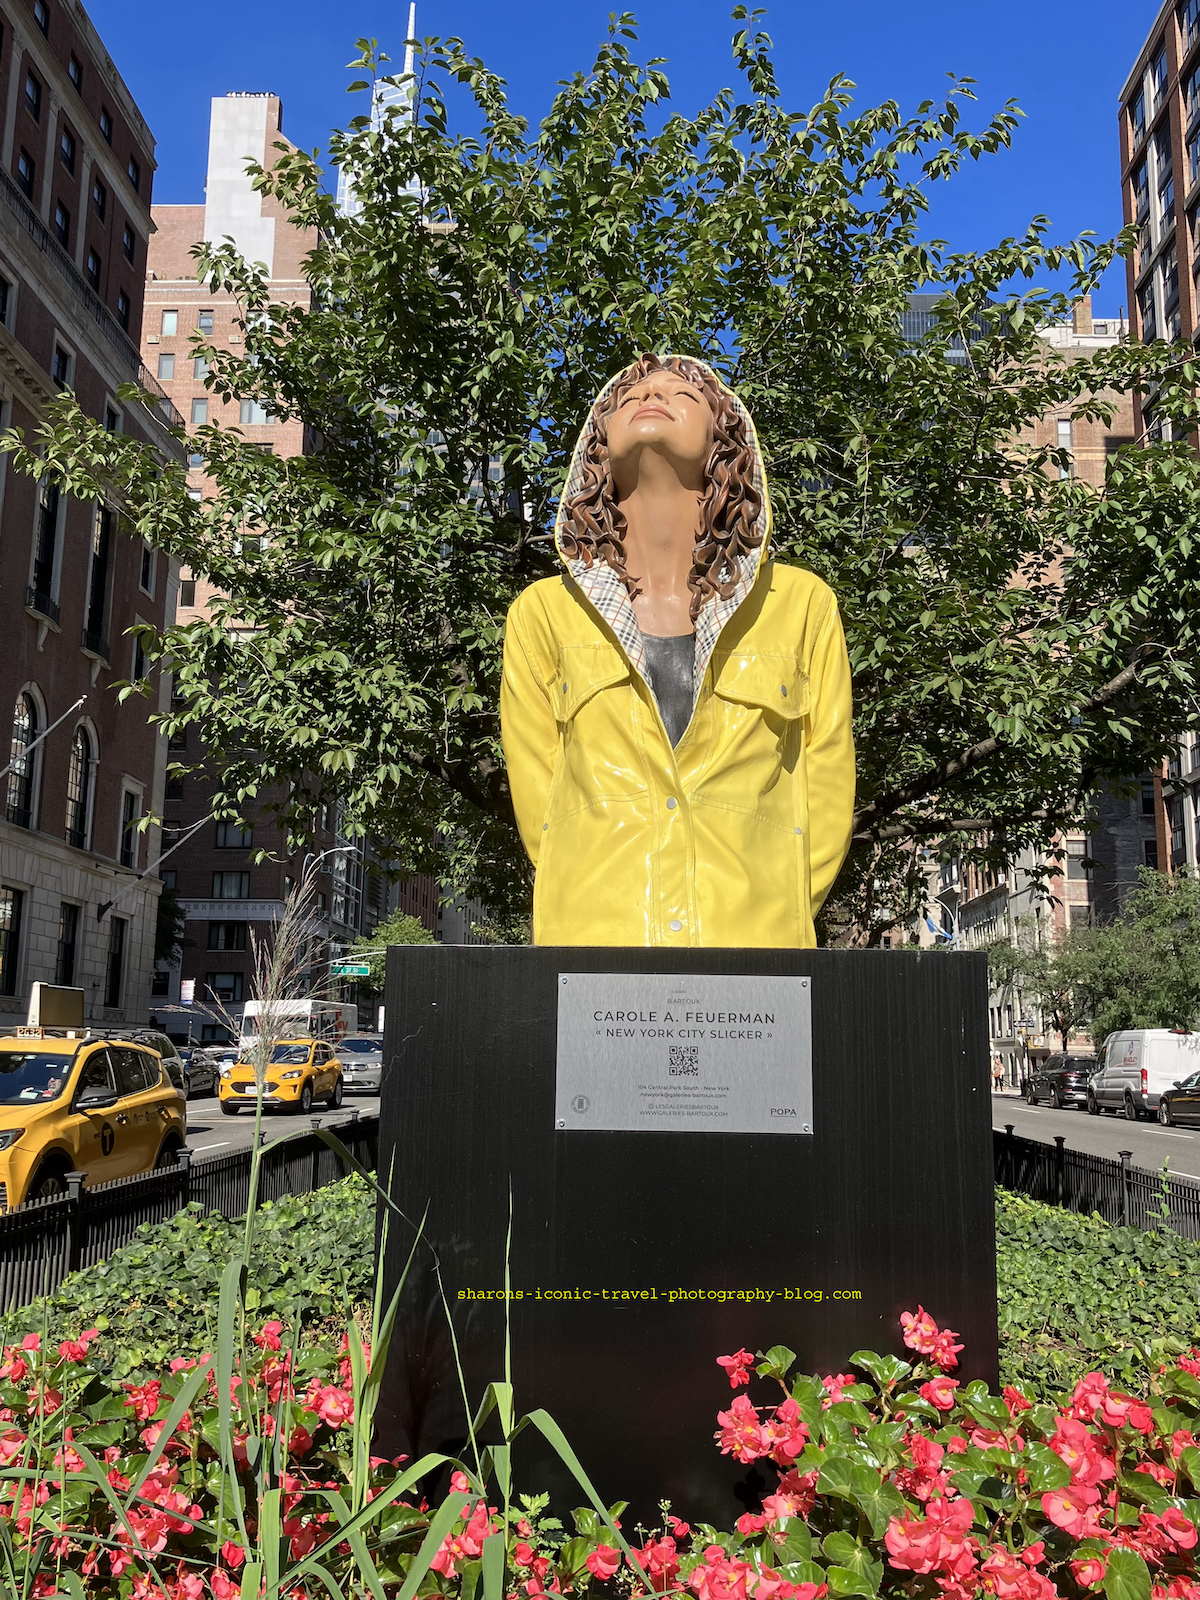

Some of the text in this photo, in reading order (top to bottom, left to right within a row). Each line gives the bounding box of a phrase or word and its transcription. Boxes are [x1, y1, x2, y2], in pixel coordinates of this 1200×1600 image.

[593, 1011, 776, 1024] CAROLE A. FEUERMAN
[606, 1028, 635, 1037] NEW
[639, 1029, 674, 1038] YORK
[678, 1029, 706, 1038] CITY
[709, 1030, 762, 1039] SLICKER
[770, 1108, 797, 1116] POPA
